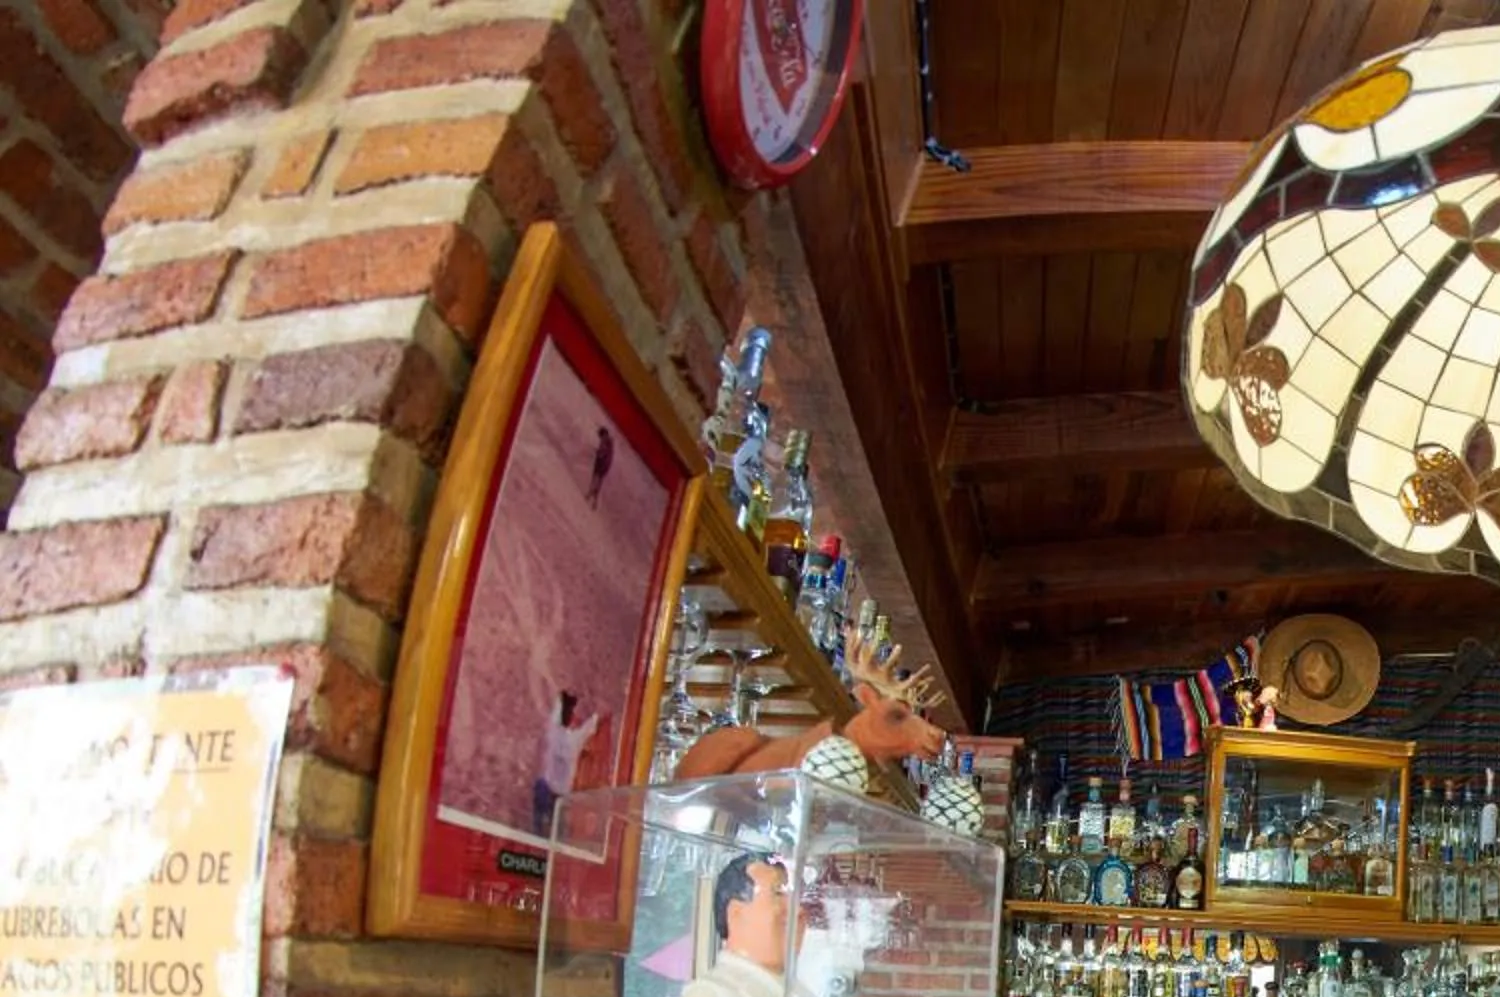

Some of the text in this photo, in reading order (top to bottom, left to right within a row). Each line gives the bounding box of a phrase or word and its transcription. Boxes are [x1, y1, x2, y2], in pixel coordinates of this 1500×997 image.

[197, 851, 233, 885] DE
[151, 906, 187, 940] EN
[0, 958, 73, 992] ACIOS
